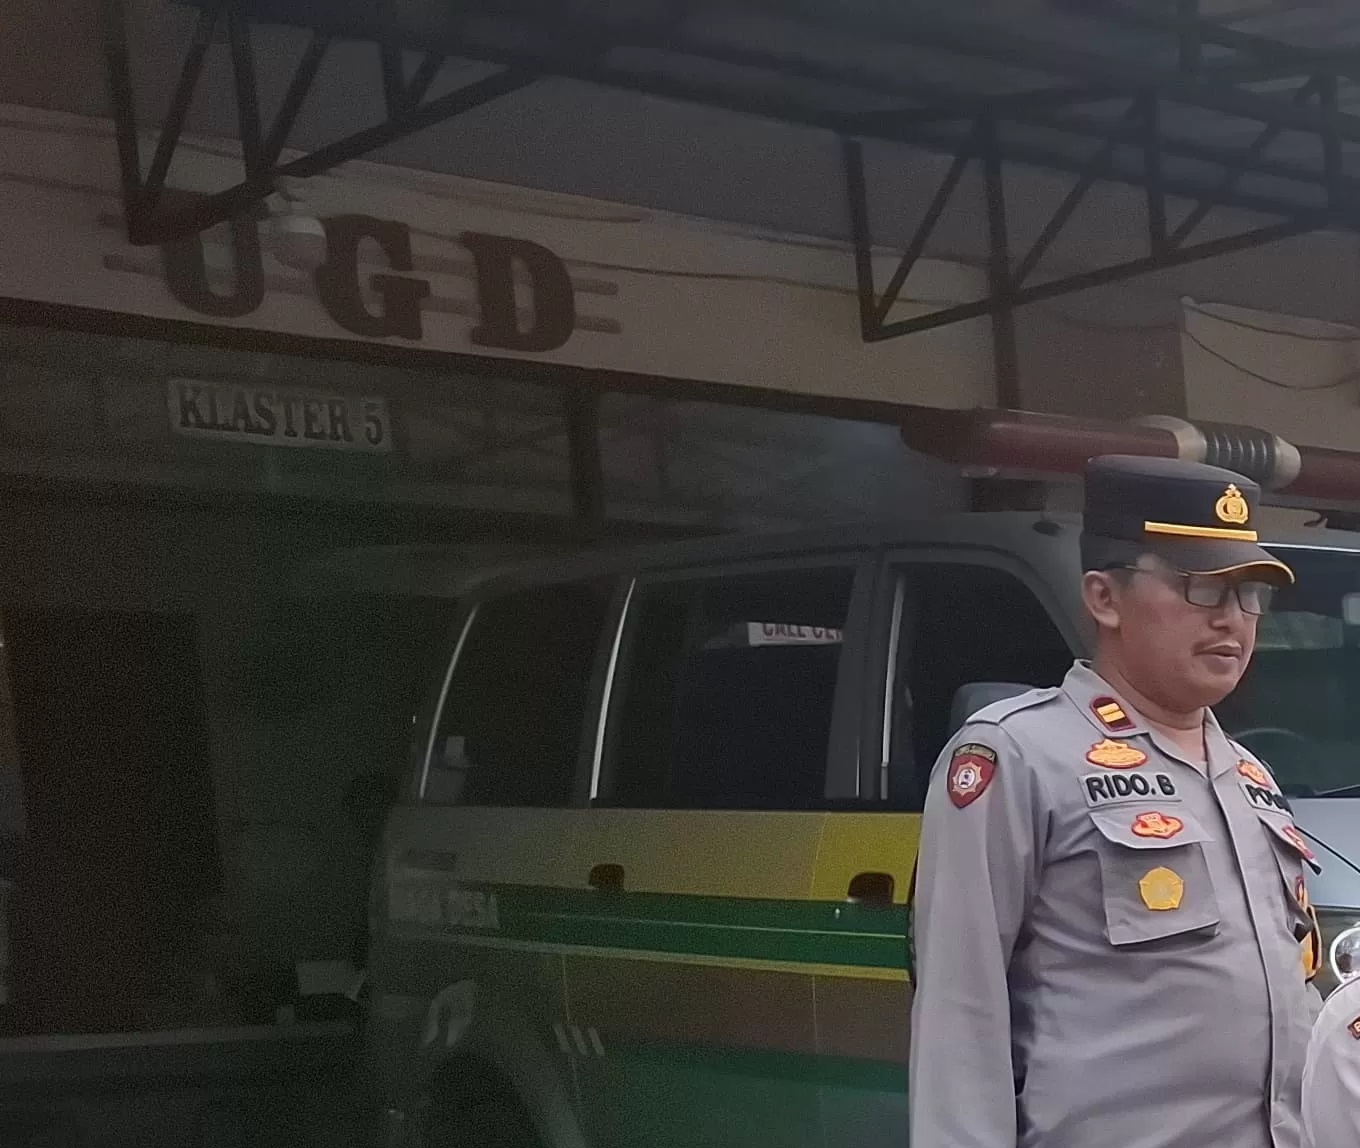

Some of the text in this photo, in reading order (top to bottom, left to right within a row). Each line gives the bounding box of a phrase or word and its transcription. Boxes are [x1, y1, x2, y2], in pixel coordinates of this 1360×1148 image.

[162, 205, 576, 353] UGD
[178, 383, 384, 446] KLASTER 5
